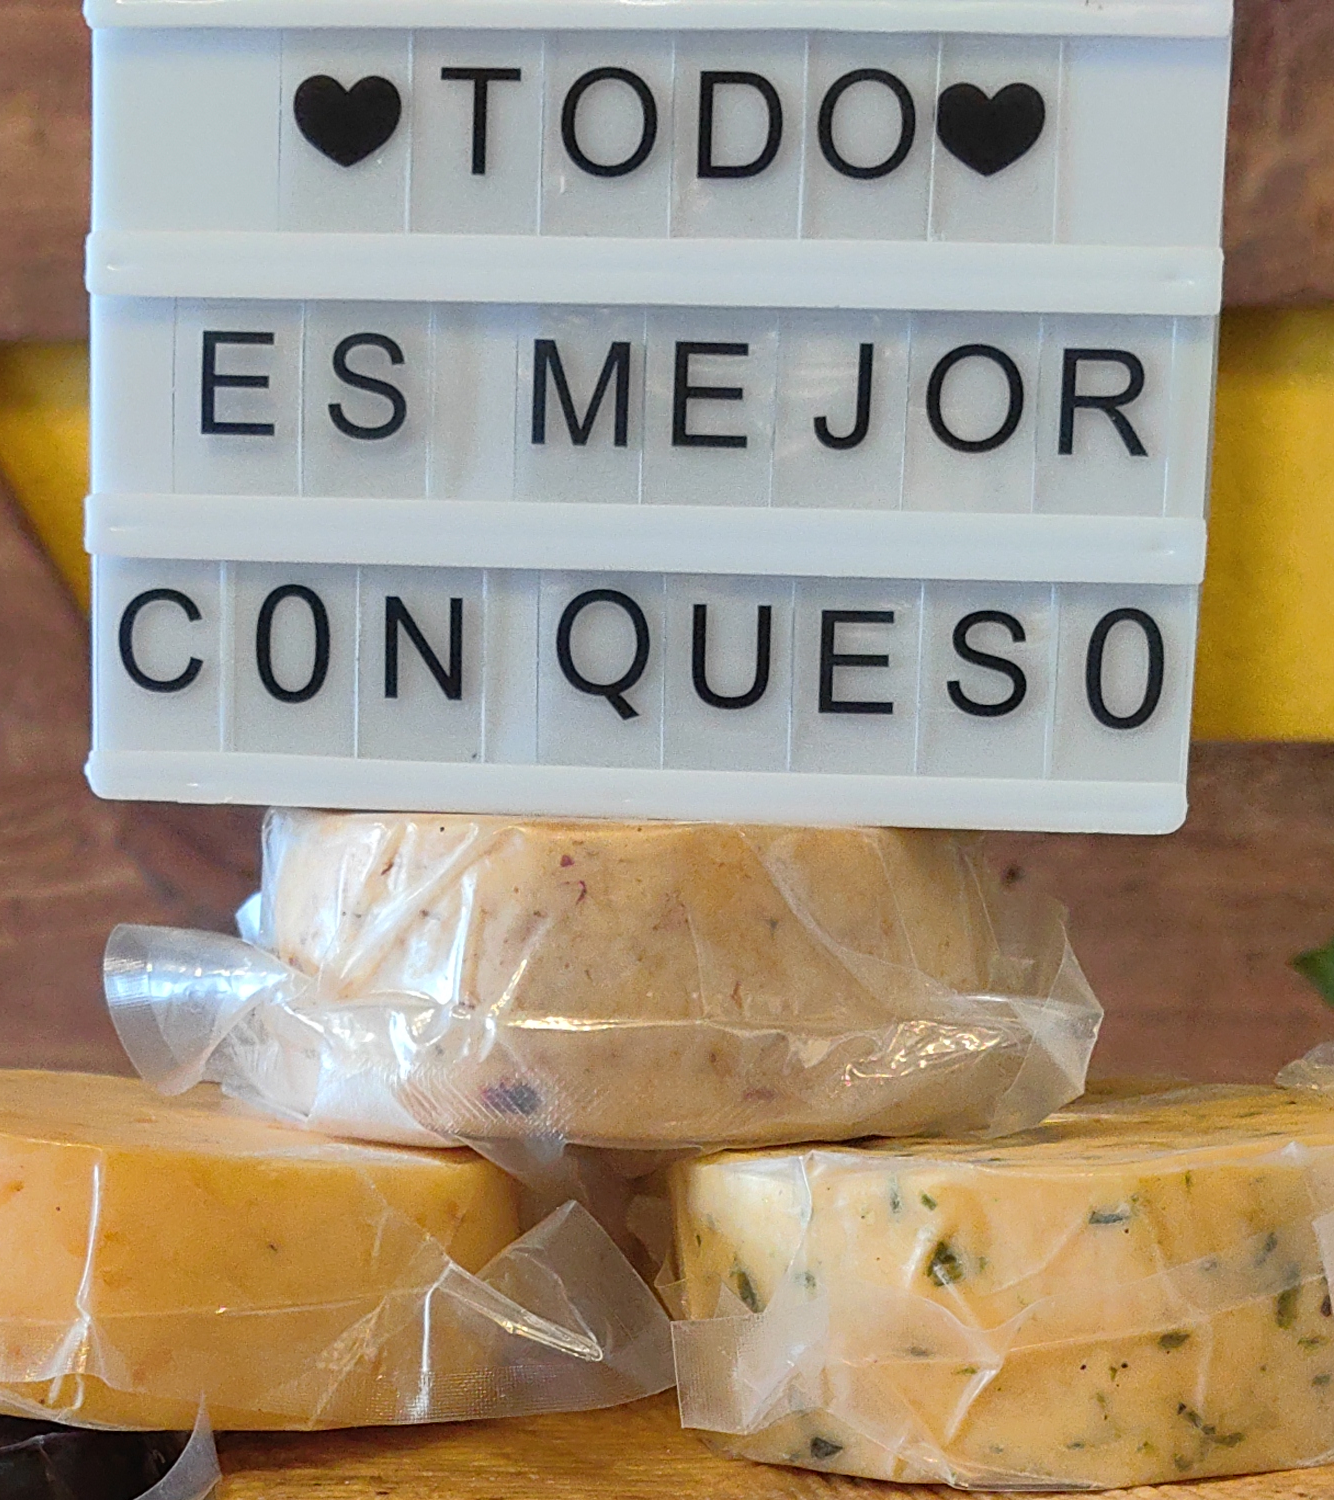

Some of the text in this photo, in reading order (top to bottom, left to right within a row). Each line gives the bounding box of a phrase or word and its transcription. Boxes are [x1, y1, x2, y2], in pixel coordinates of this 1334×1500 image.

[440, 66, 917, 181] TODO
[201, 330, 1148, 457] ES MEJOR
